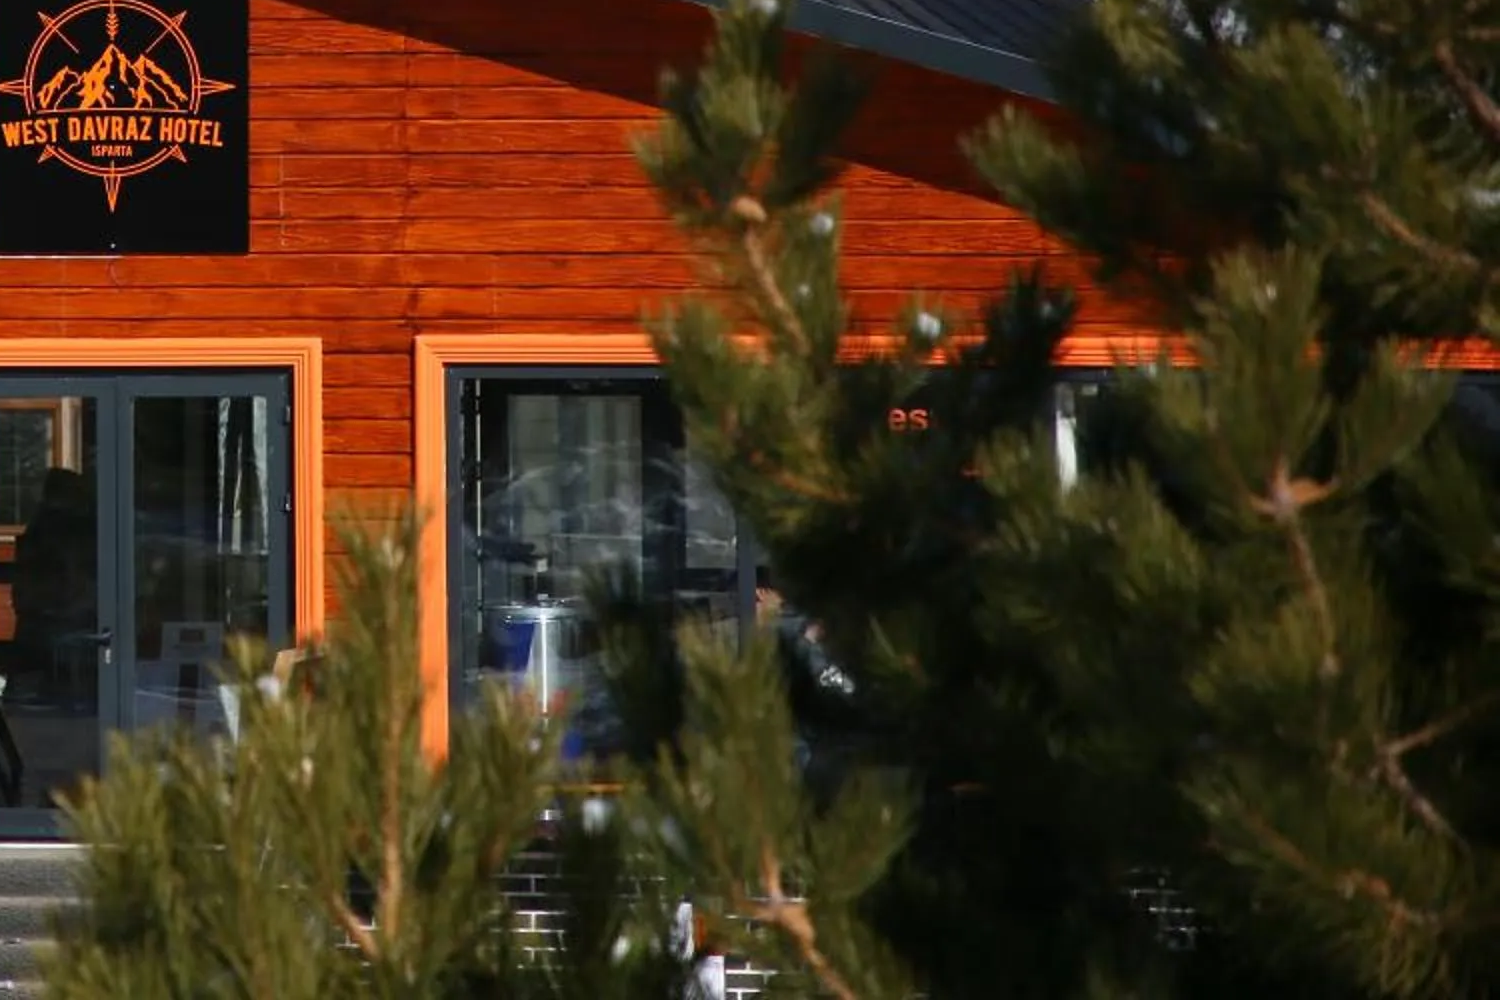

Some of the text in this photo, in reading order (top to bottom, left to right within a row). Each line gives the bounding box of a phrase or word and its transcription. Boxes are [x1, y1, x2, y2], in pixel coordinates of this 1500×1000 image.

[1, 115, 224, 148] WEST DAVRAZ HOTEL
[91, 144, 133, 157] ISPARTA
